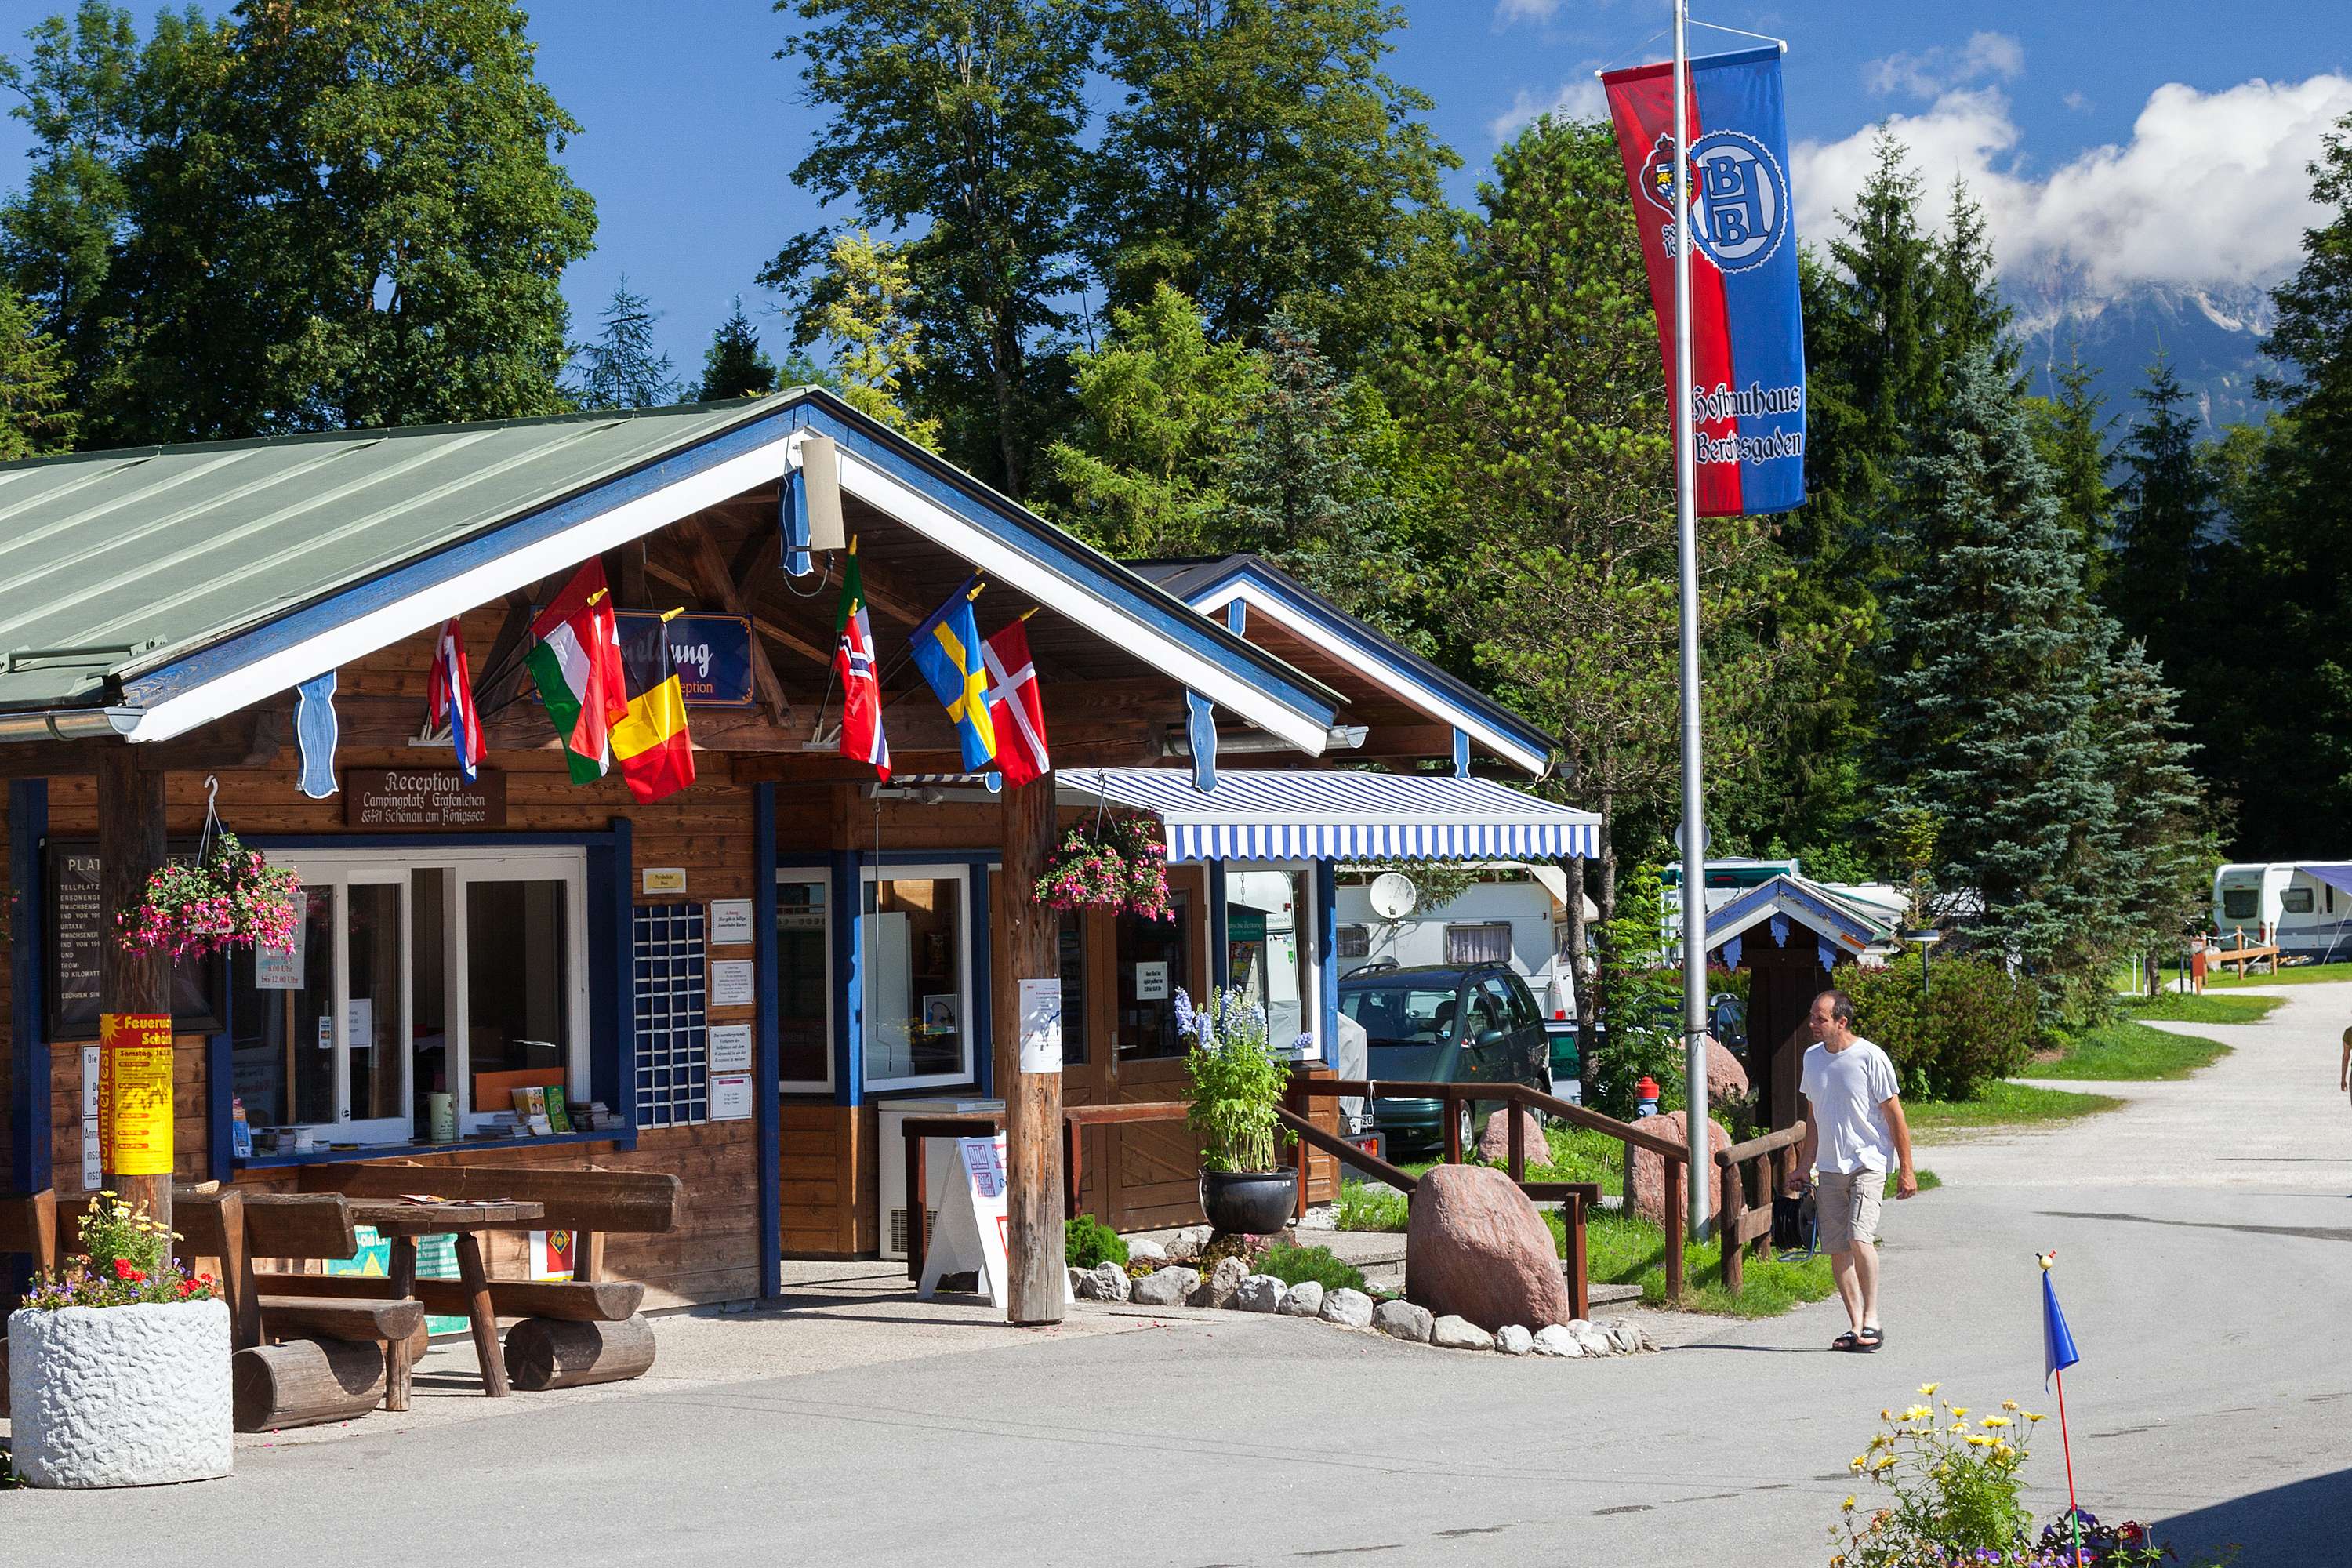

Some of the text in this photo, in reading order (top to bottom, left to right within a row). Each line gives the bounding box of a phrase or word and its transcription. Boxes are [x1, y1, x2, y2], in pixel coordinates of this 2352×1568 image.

[1691, 381, 1801, 423] Hofbuhaus
[1693, 427, 1802, 466] Bercesgaden
[680, 681, 713, 696] eption
[384, 771, 461, 795] Reception
[363, 792, 485, 809] Campingplatz Grafenlehen
[361, 807, 485, 826] 83471 Schönau am Königssee
[88, 1054, 98, 1064] Die
[967, 1146, 989, 1165] Bild
[977, 1174, 991, 1185] Bild
